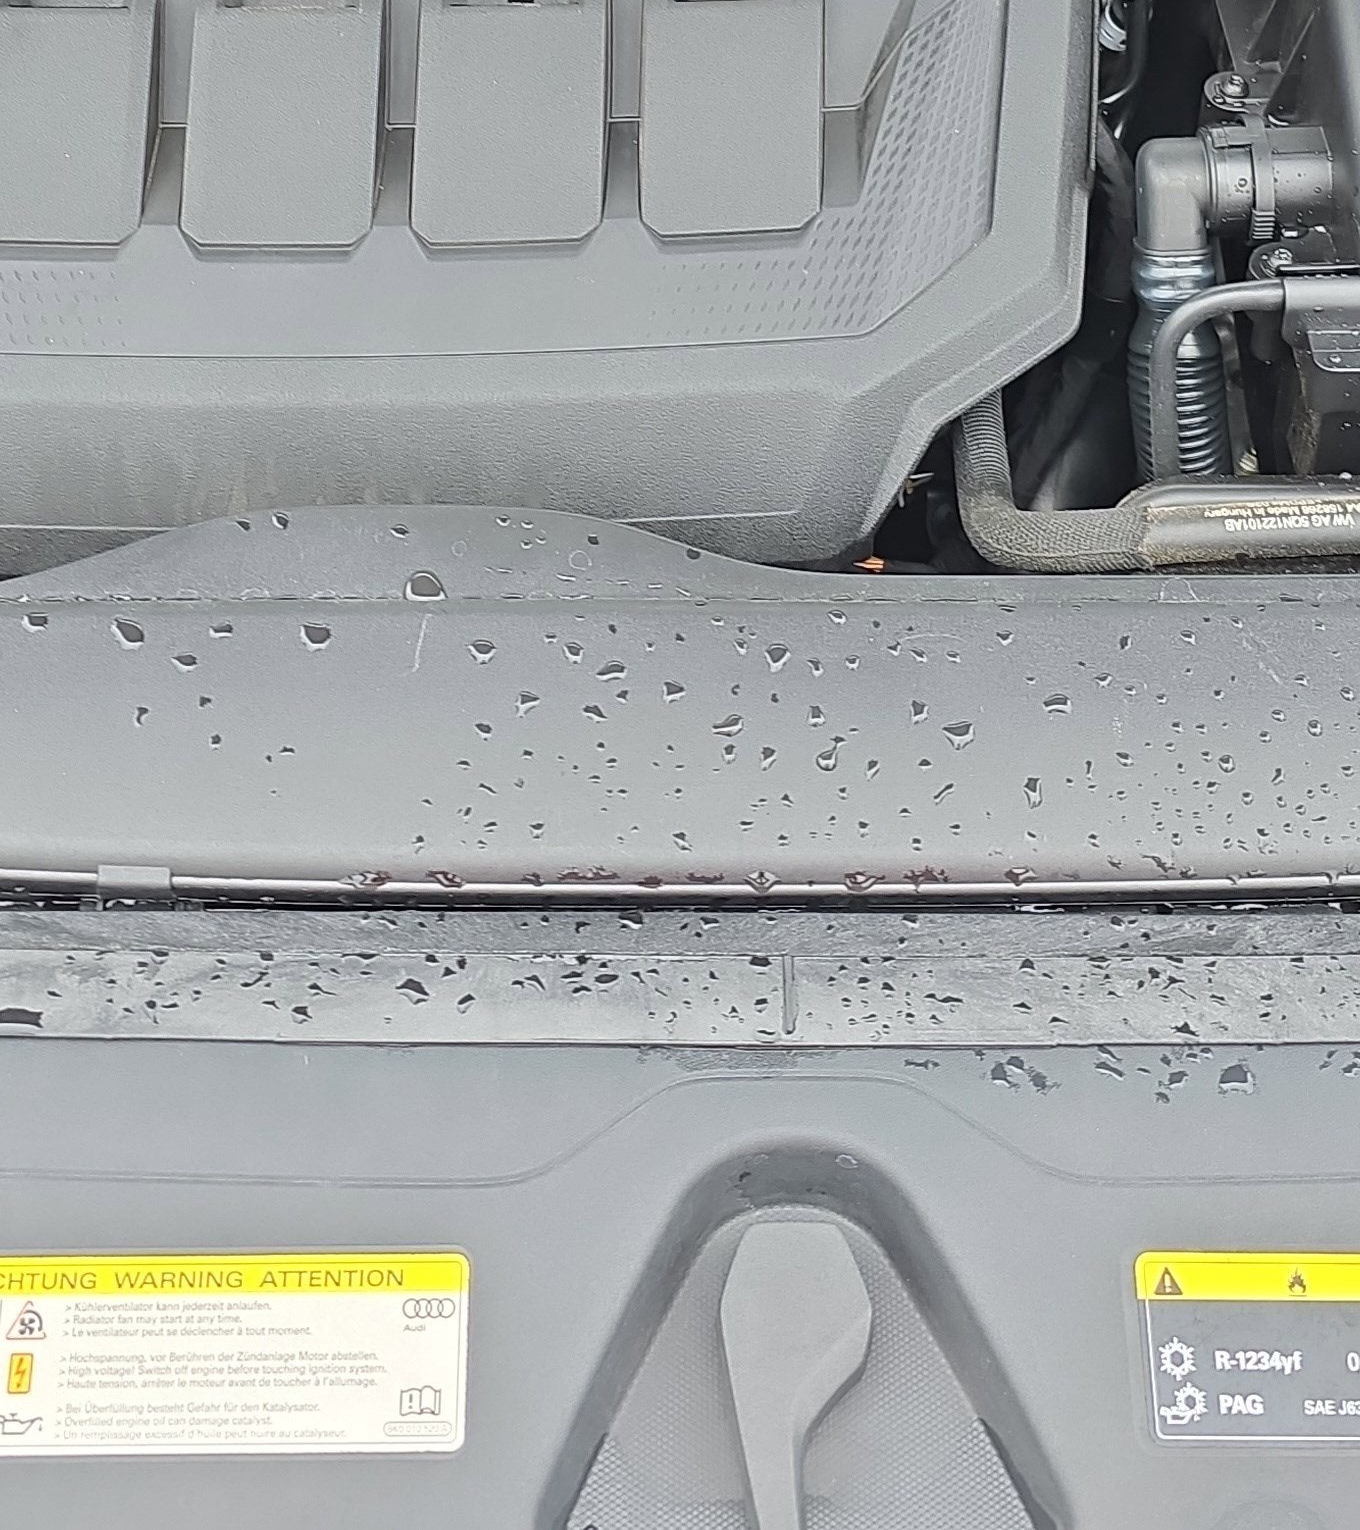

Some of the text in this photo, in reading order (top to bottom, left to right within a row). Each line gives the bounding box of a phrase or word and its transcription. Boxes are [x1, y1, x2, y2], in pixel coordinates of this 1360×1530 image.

[1204, 506, 1252, 518] Hungary
[1254, 507, 1265, 516] in
[1267, 505, 1300, 516] Made
[1312, 514, 1330, 528] AG
[1333, 512, 1355, 528] VW
[115, 1271, 243, 1289] WARNING
[259, 1269, 404, 1287] ATTENTION
[156, 1302, 179, 1311] kann
[227, 1301, 271, 1310] anlaufen.
[74, 1315, 115, 1324] Radiator
[117, 1315, 132, 1324] fan
[136, 1316, 157, 1326] may
[160, 1315, 182, 1323] start
[185, 1315, 194, 1323] at
[197, 1316, 215, 1325] any
[72, 1328, 84, 1337] Le
[86, 1327, 139, 1336] ventilateur
[142, 1328, 164, 1338] peut
[246, 1327, 265, 1335] tout
[403, 1324, 426, 1332] Audi
[169, 1352, 215, 1362] Berühren
[218, 1352, 234, 1361] der
[236, 1351, 296, 1362] Zündanlage
[298, 1351, 328, 1360] Motor
[1214, 1350, 1303, 1376] R-1234yf
[68, 1366, 91, 1378] High
[138, 1365, 171, 1375] Switch
[191, 1366, 224, 1376] engine
[228, 1365, 259, 1374] before
[262, 1364, 306, 1374] touching
[1218, 1394, 1265, 1415] PAG
[1303, 1399, 1336, 1415] SAE
